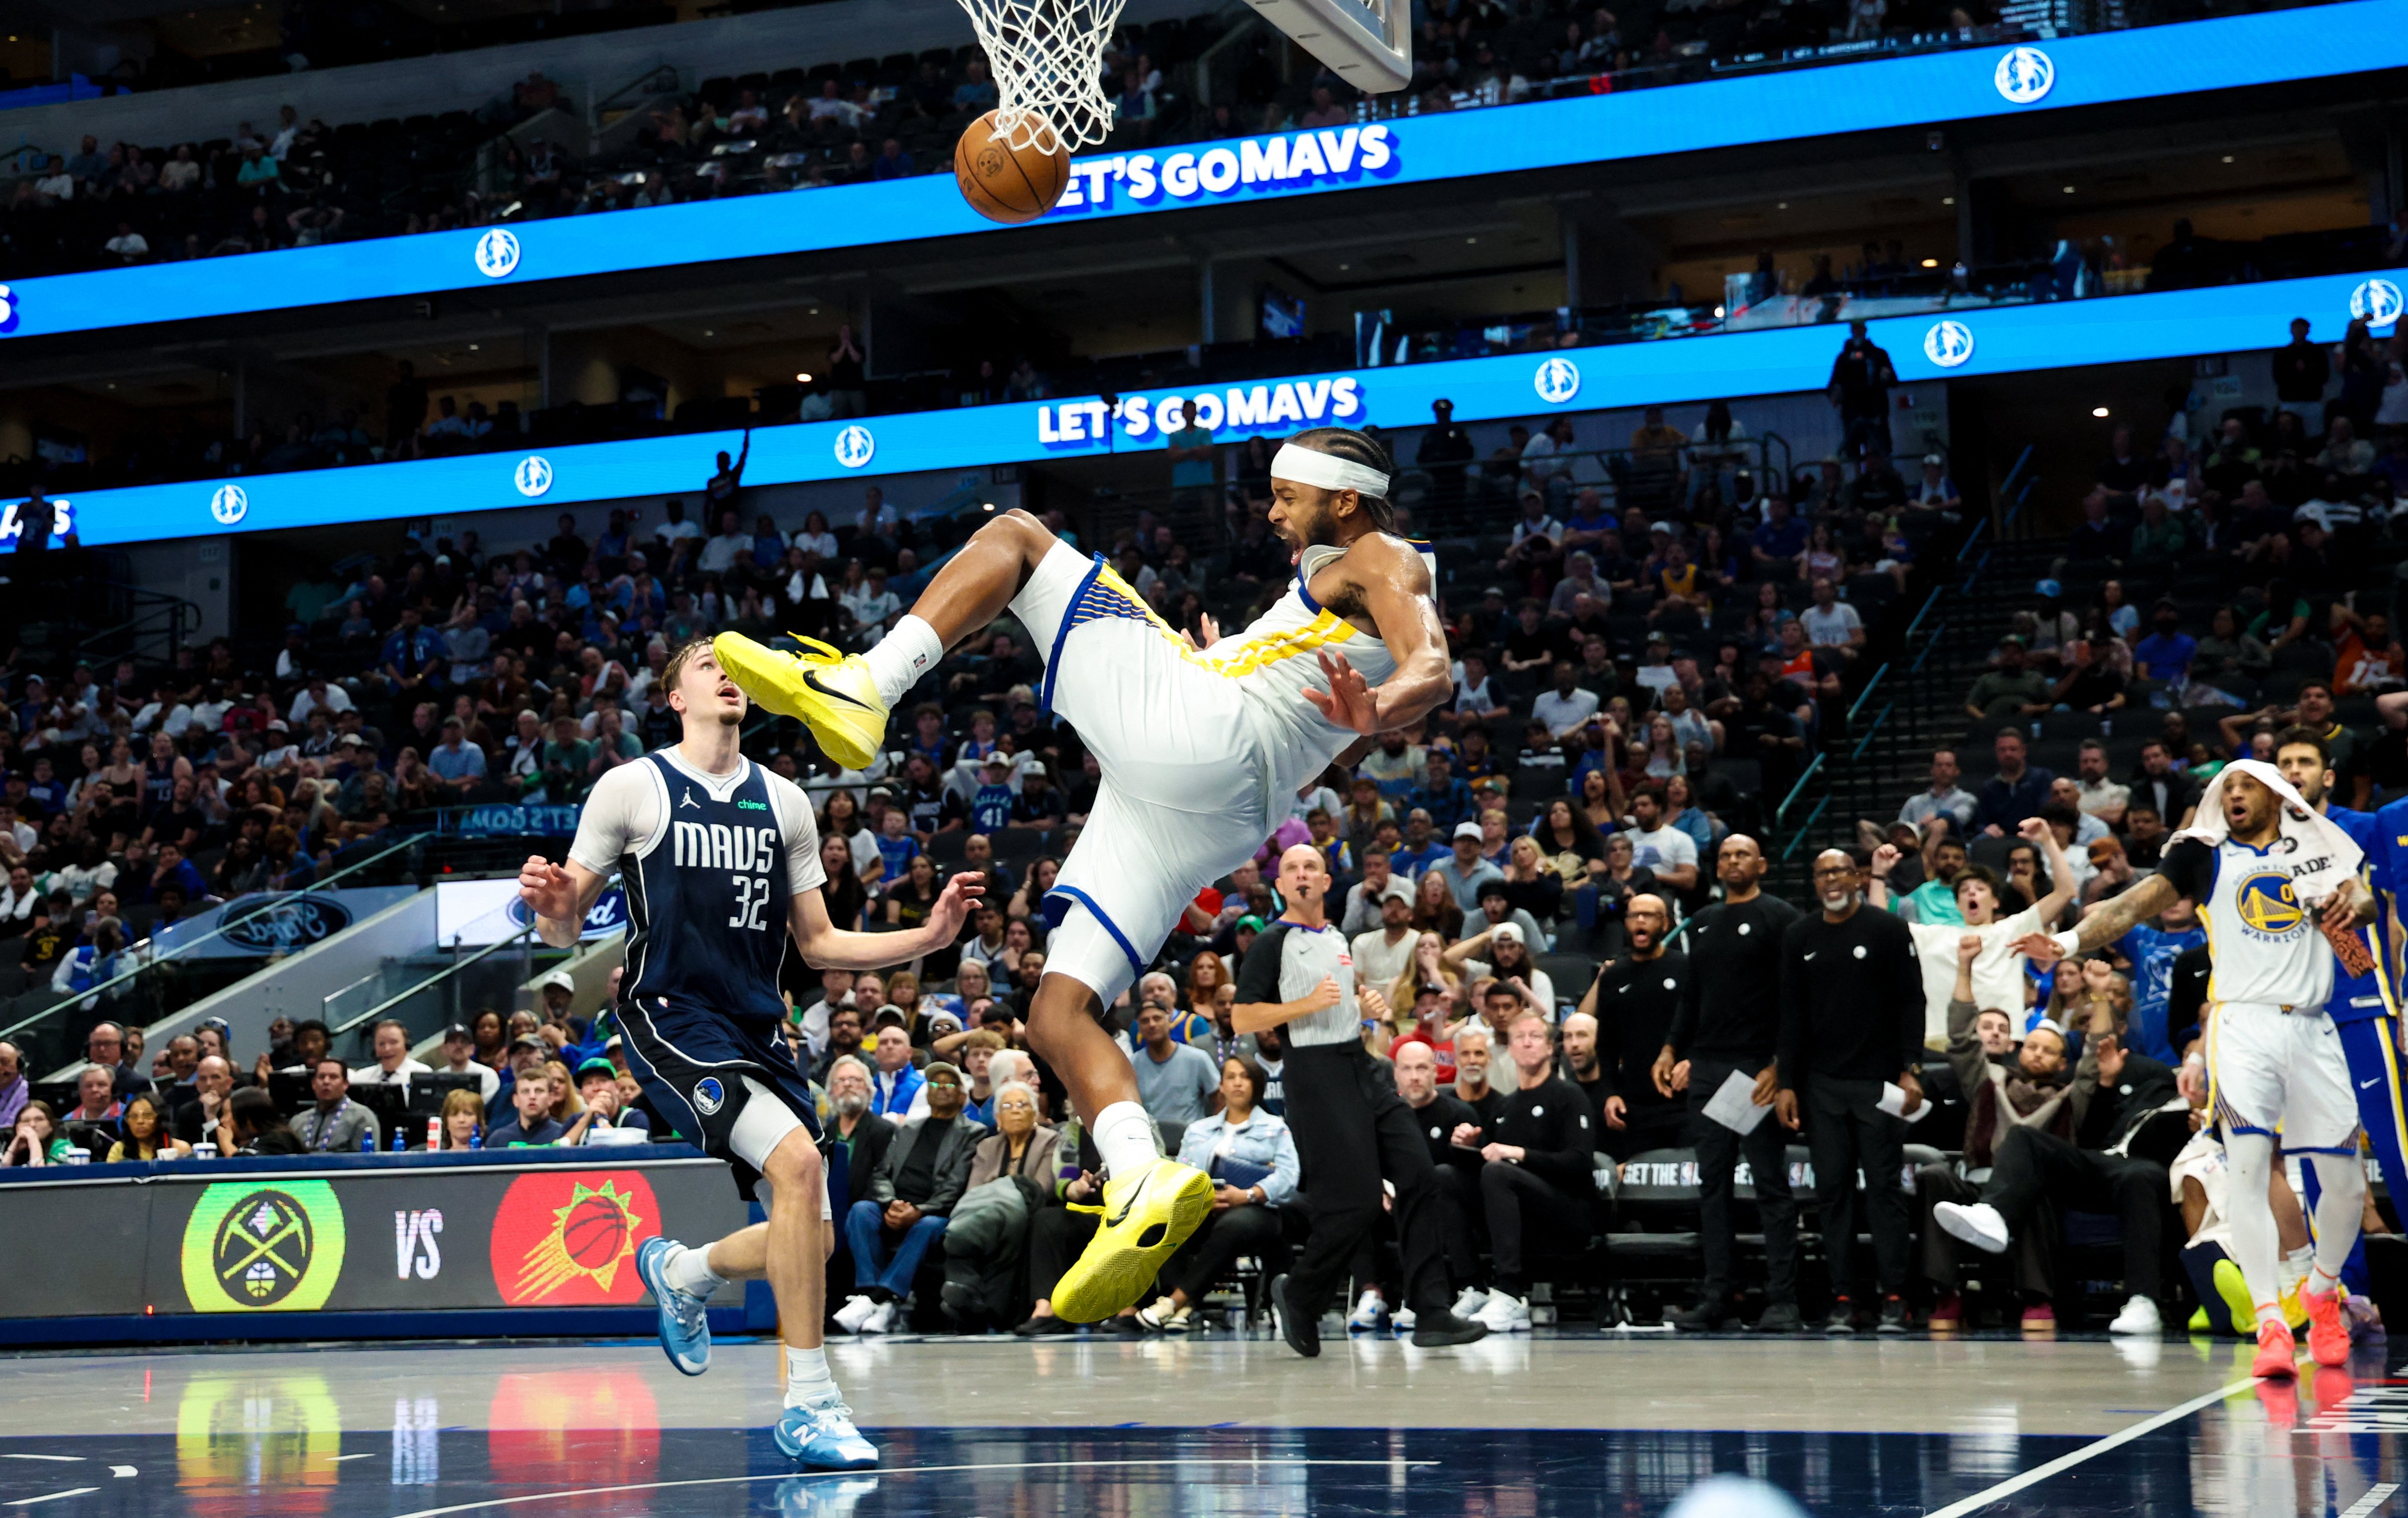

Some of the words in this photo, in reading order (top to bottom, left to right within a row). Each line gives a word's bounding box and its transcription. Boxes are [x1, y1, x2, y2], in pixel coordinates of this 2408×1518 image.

[1056, 154, 1156, 207] ET'S
[1038, 396, 1150, 443] LET'S
[737, 799, 767, 811] chime
[979, 807, 1003, 827] 41
[674, 821, 776, 873] MAVS
[729, 875, 769, 931] 32
[2280, 883, 2294, 903] 0
[1623, 1163, 1650, 1185] GET
[1650, 1162, 1679, 1186] THE
[395, 1208, 444, 1280] VS
